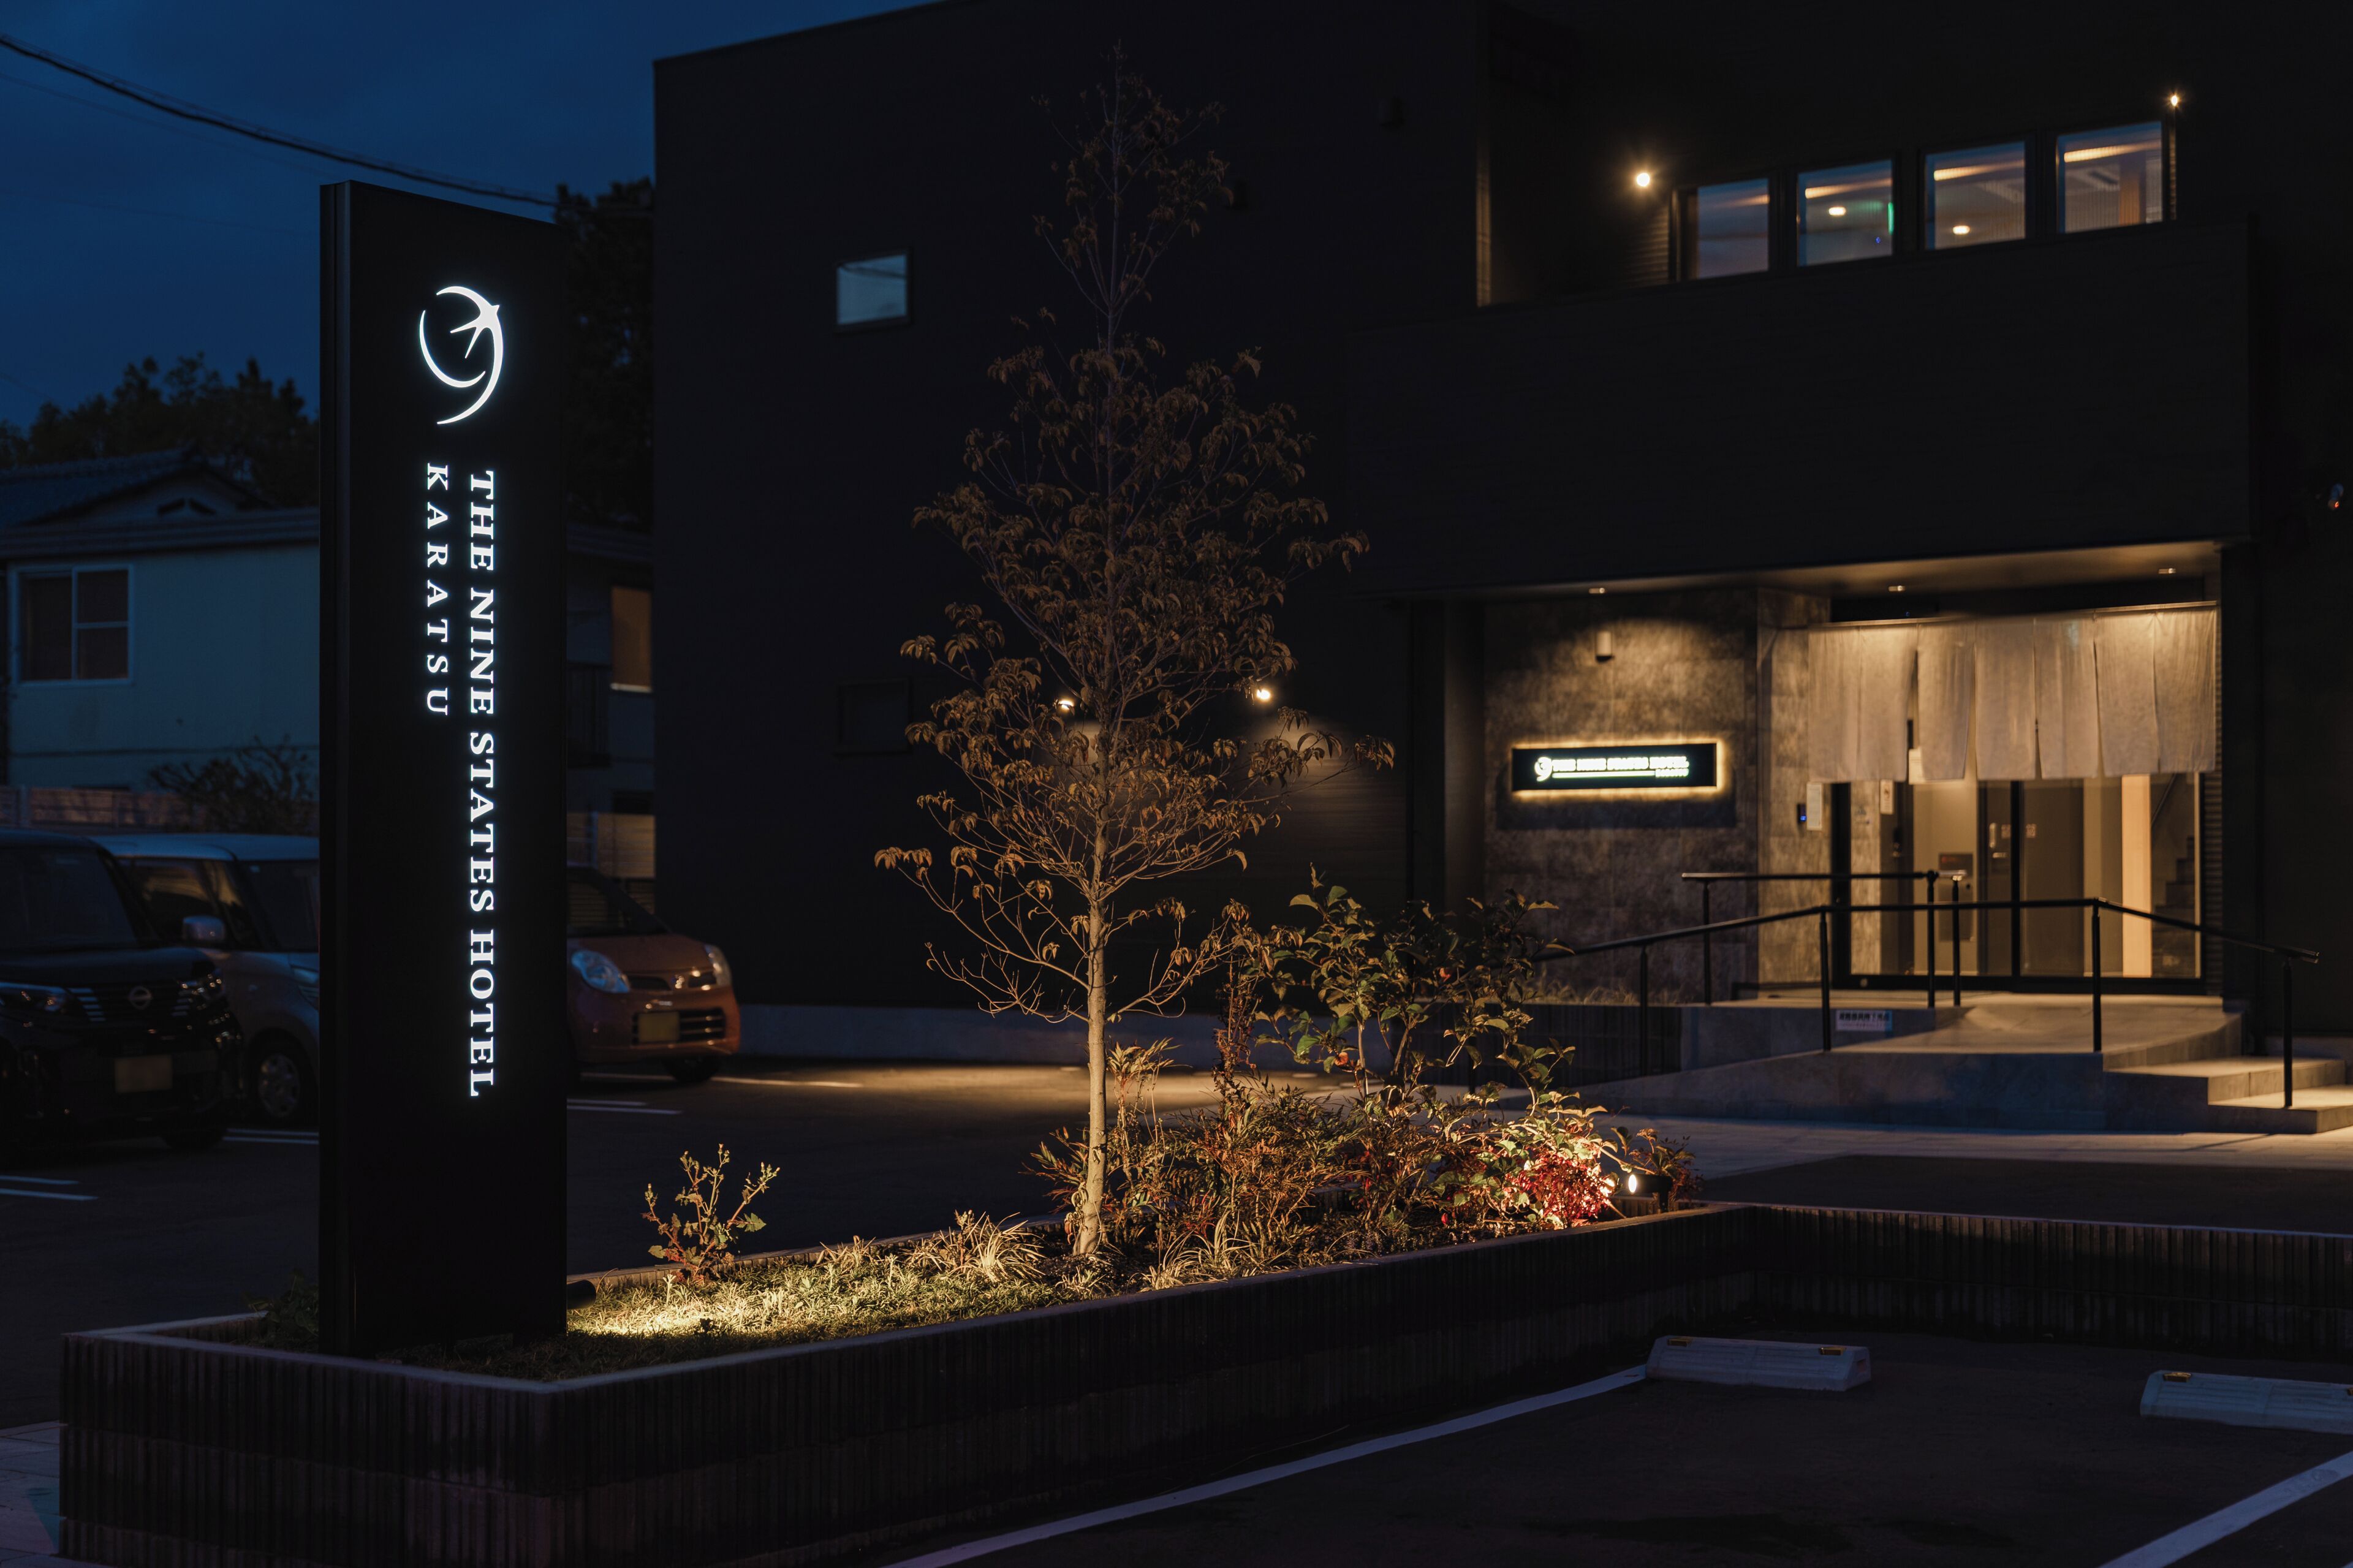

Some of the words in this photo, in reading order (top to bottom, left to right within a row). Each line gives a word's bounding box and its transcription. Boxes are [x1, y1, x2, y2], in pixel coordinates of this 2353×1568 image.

[426, 462, 448, 716] KARATSU
[470, 470, 494, 571] THE
[470, 586, 494, 715] NINE
[470, 731, 494, 912] STATES
[470, 928, 494, 1097] HOTEL
